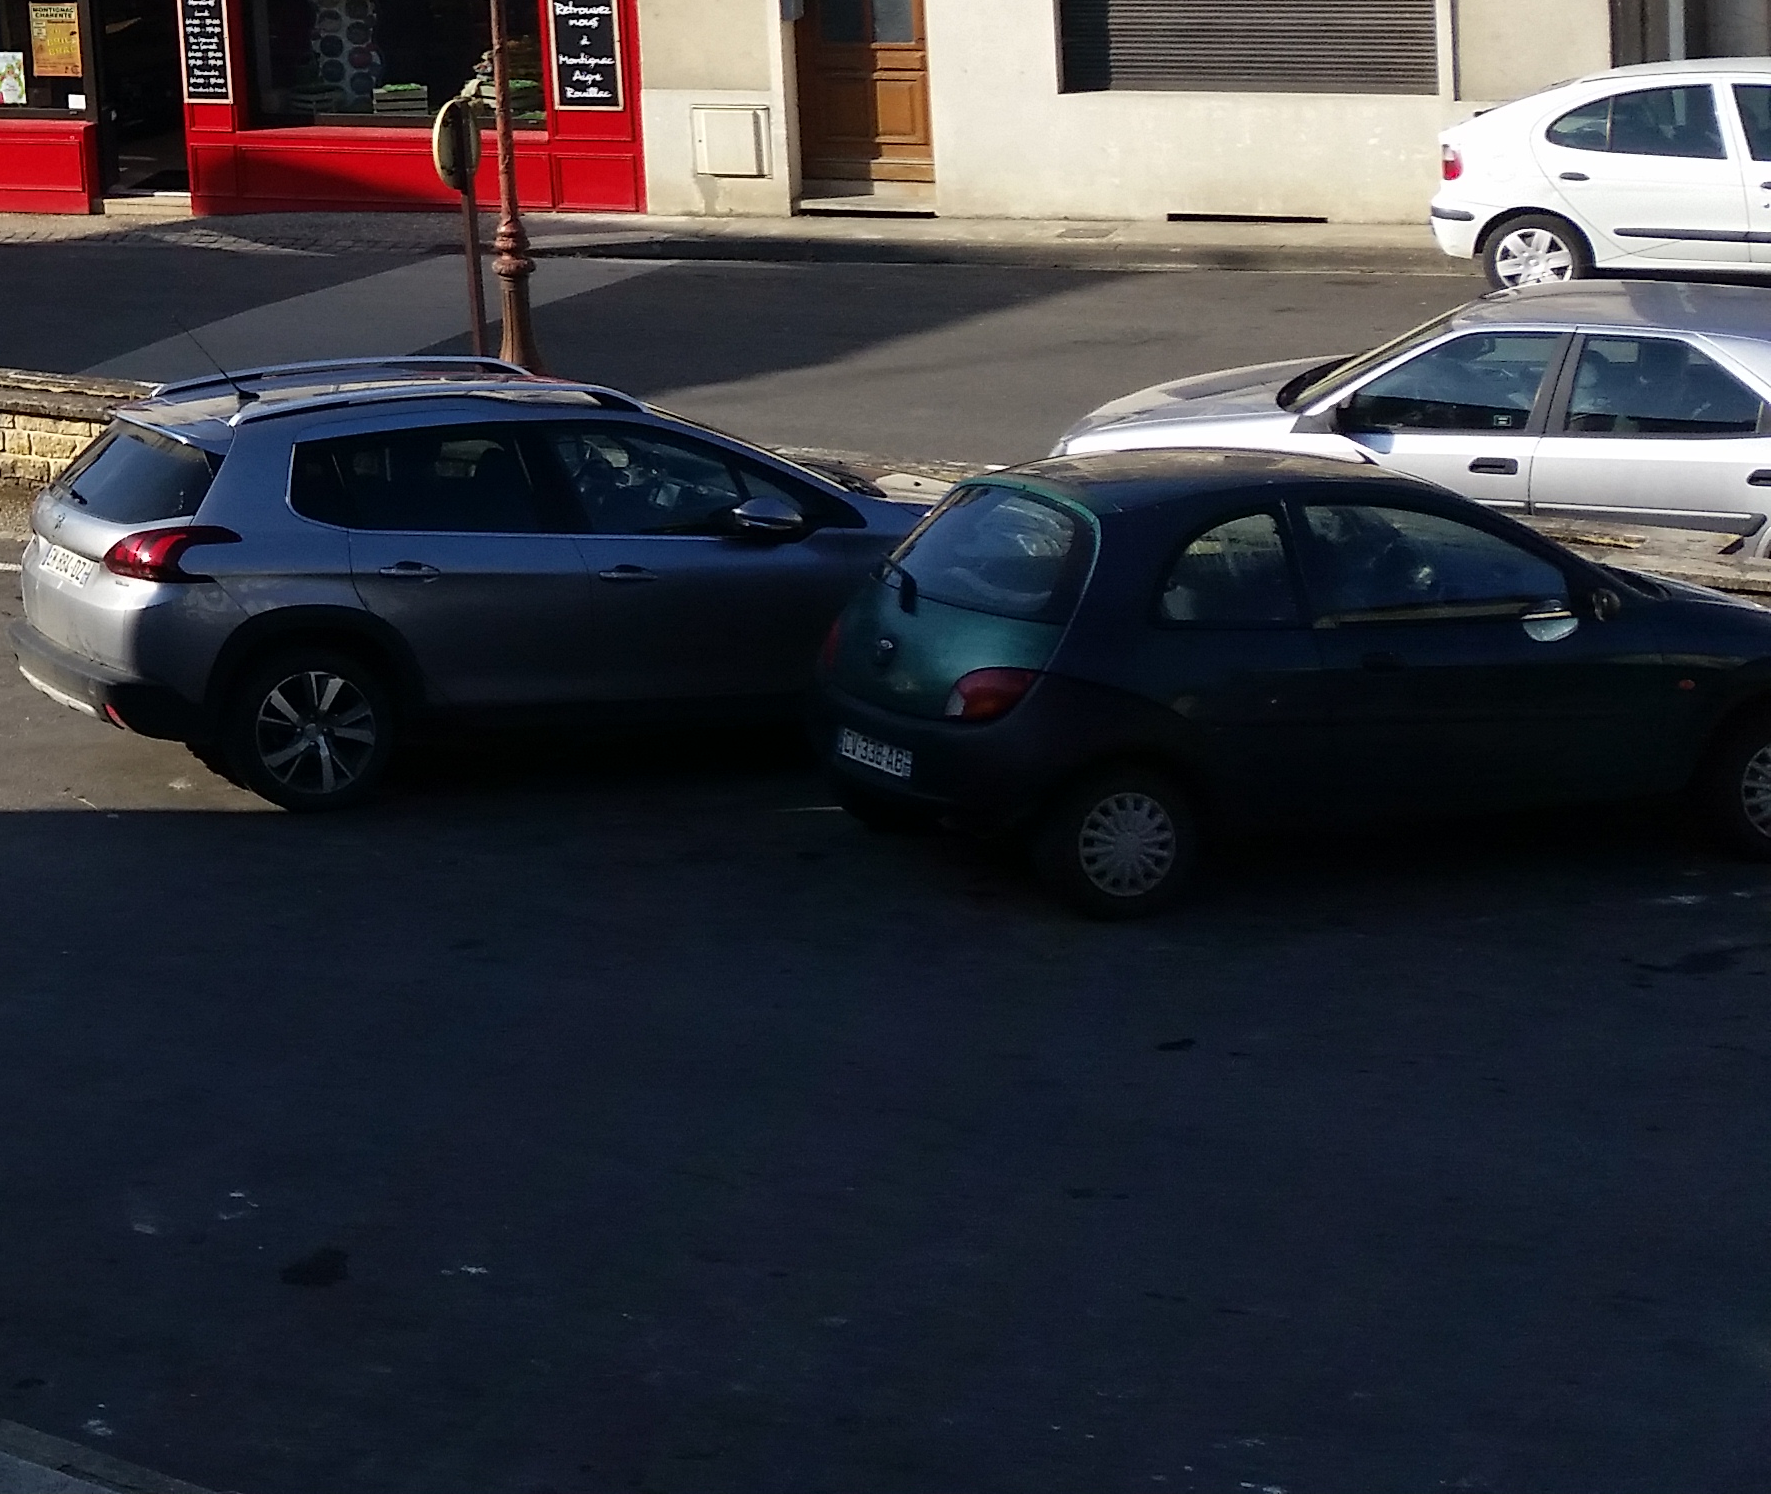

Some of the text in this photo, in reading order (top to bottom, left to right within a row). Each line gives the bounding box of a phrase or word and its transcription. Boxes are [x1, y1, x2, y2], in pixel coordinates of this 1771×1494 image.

[554, 1, 612, 16] Retrouvez
[568, 17, 599, 28] nous
[580, 35, 591, 46] à
[559, 53, 615, 68] Montignac
[572, 70, 604, 85] Aigre
[565, 86, 613, 99] Rouillac
